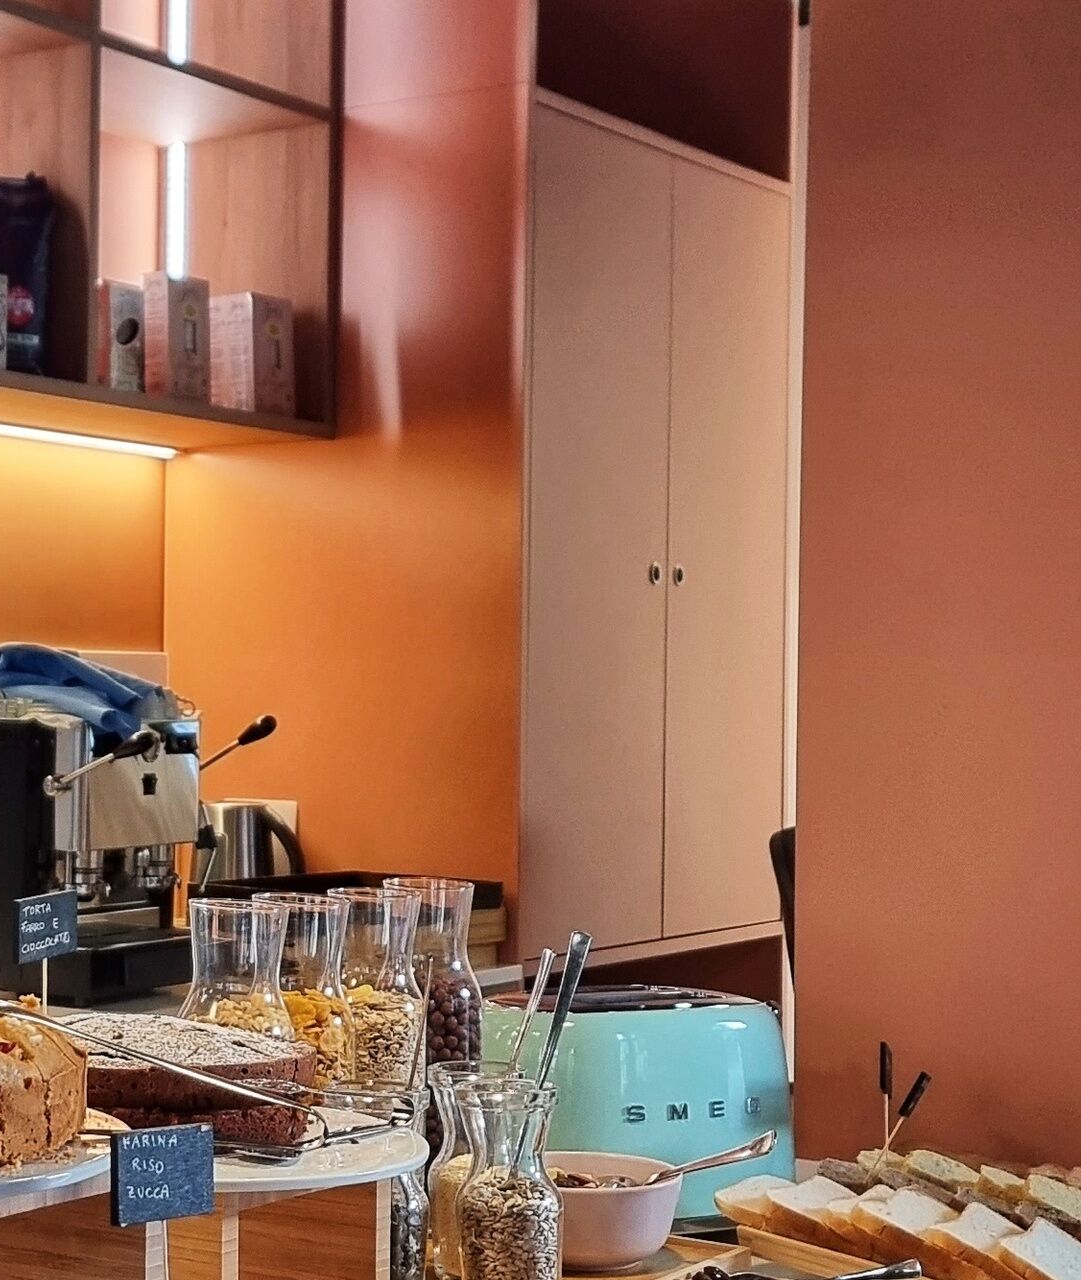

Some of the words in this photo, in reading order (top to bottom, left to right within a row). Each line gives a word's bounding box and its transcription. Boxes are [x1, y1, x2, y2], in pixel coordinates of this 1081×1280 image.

[22, 903, 52, 917] TORTA
[52, 917, 60, 929] E
[21, 931, 71, 954] CIOCCOLATO
[122, 1134, 178, 1150] FARINA
[131, 1157, 164, 1174] RISO
[126, 1183, 170, 1199] ZUCCA
